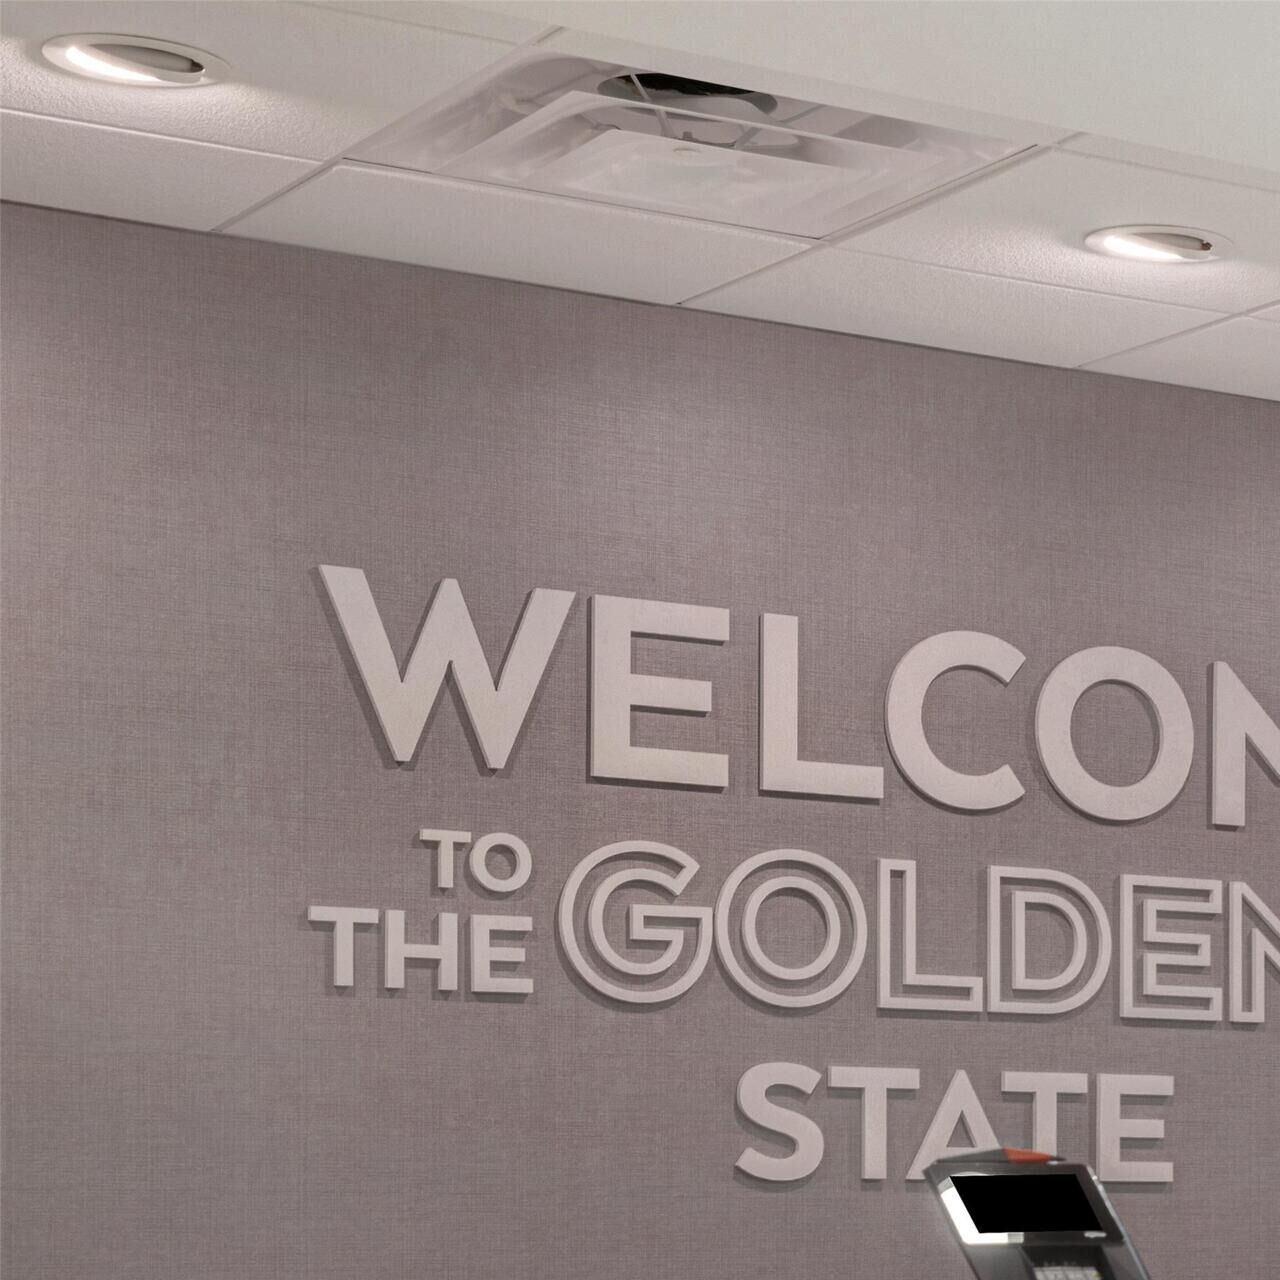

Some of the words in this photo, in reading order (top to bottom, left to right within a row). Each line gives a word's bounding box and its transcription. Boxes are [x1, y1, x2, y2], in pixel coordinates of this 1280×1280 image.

[419, 827, 534, 893] TO
[307, 904, 535, 995] THE
[734, 1059, 1175, 1184] STATE
